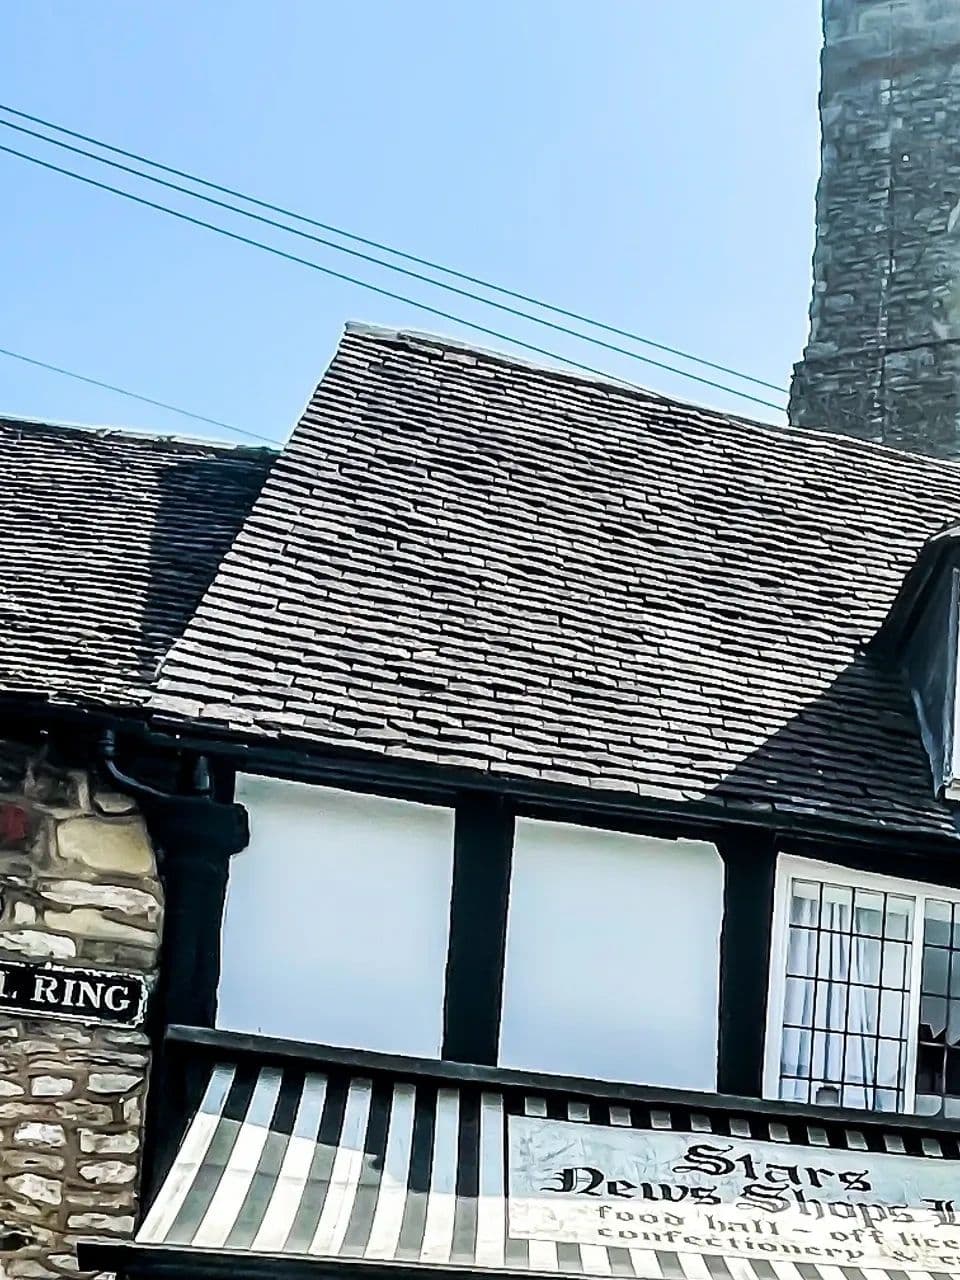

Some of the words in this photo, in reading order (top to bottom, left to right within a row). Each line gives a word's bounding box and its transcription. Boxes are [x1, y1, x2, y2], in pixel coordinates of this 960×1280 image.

[30, 974, 130, 1011] RING
[672, 1144, 872, 1192] Stars
[539, 1166, 722, 1205] News
[735, 1183, 915, 1229] Shops
[597, 1204, 686, 1227] food
[705, 1213, 780, 1236] hall
[829, 1225, 884, 1246] off
[597, 1226, 865, 1263] confectionery
